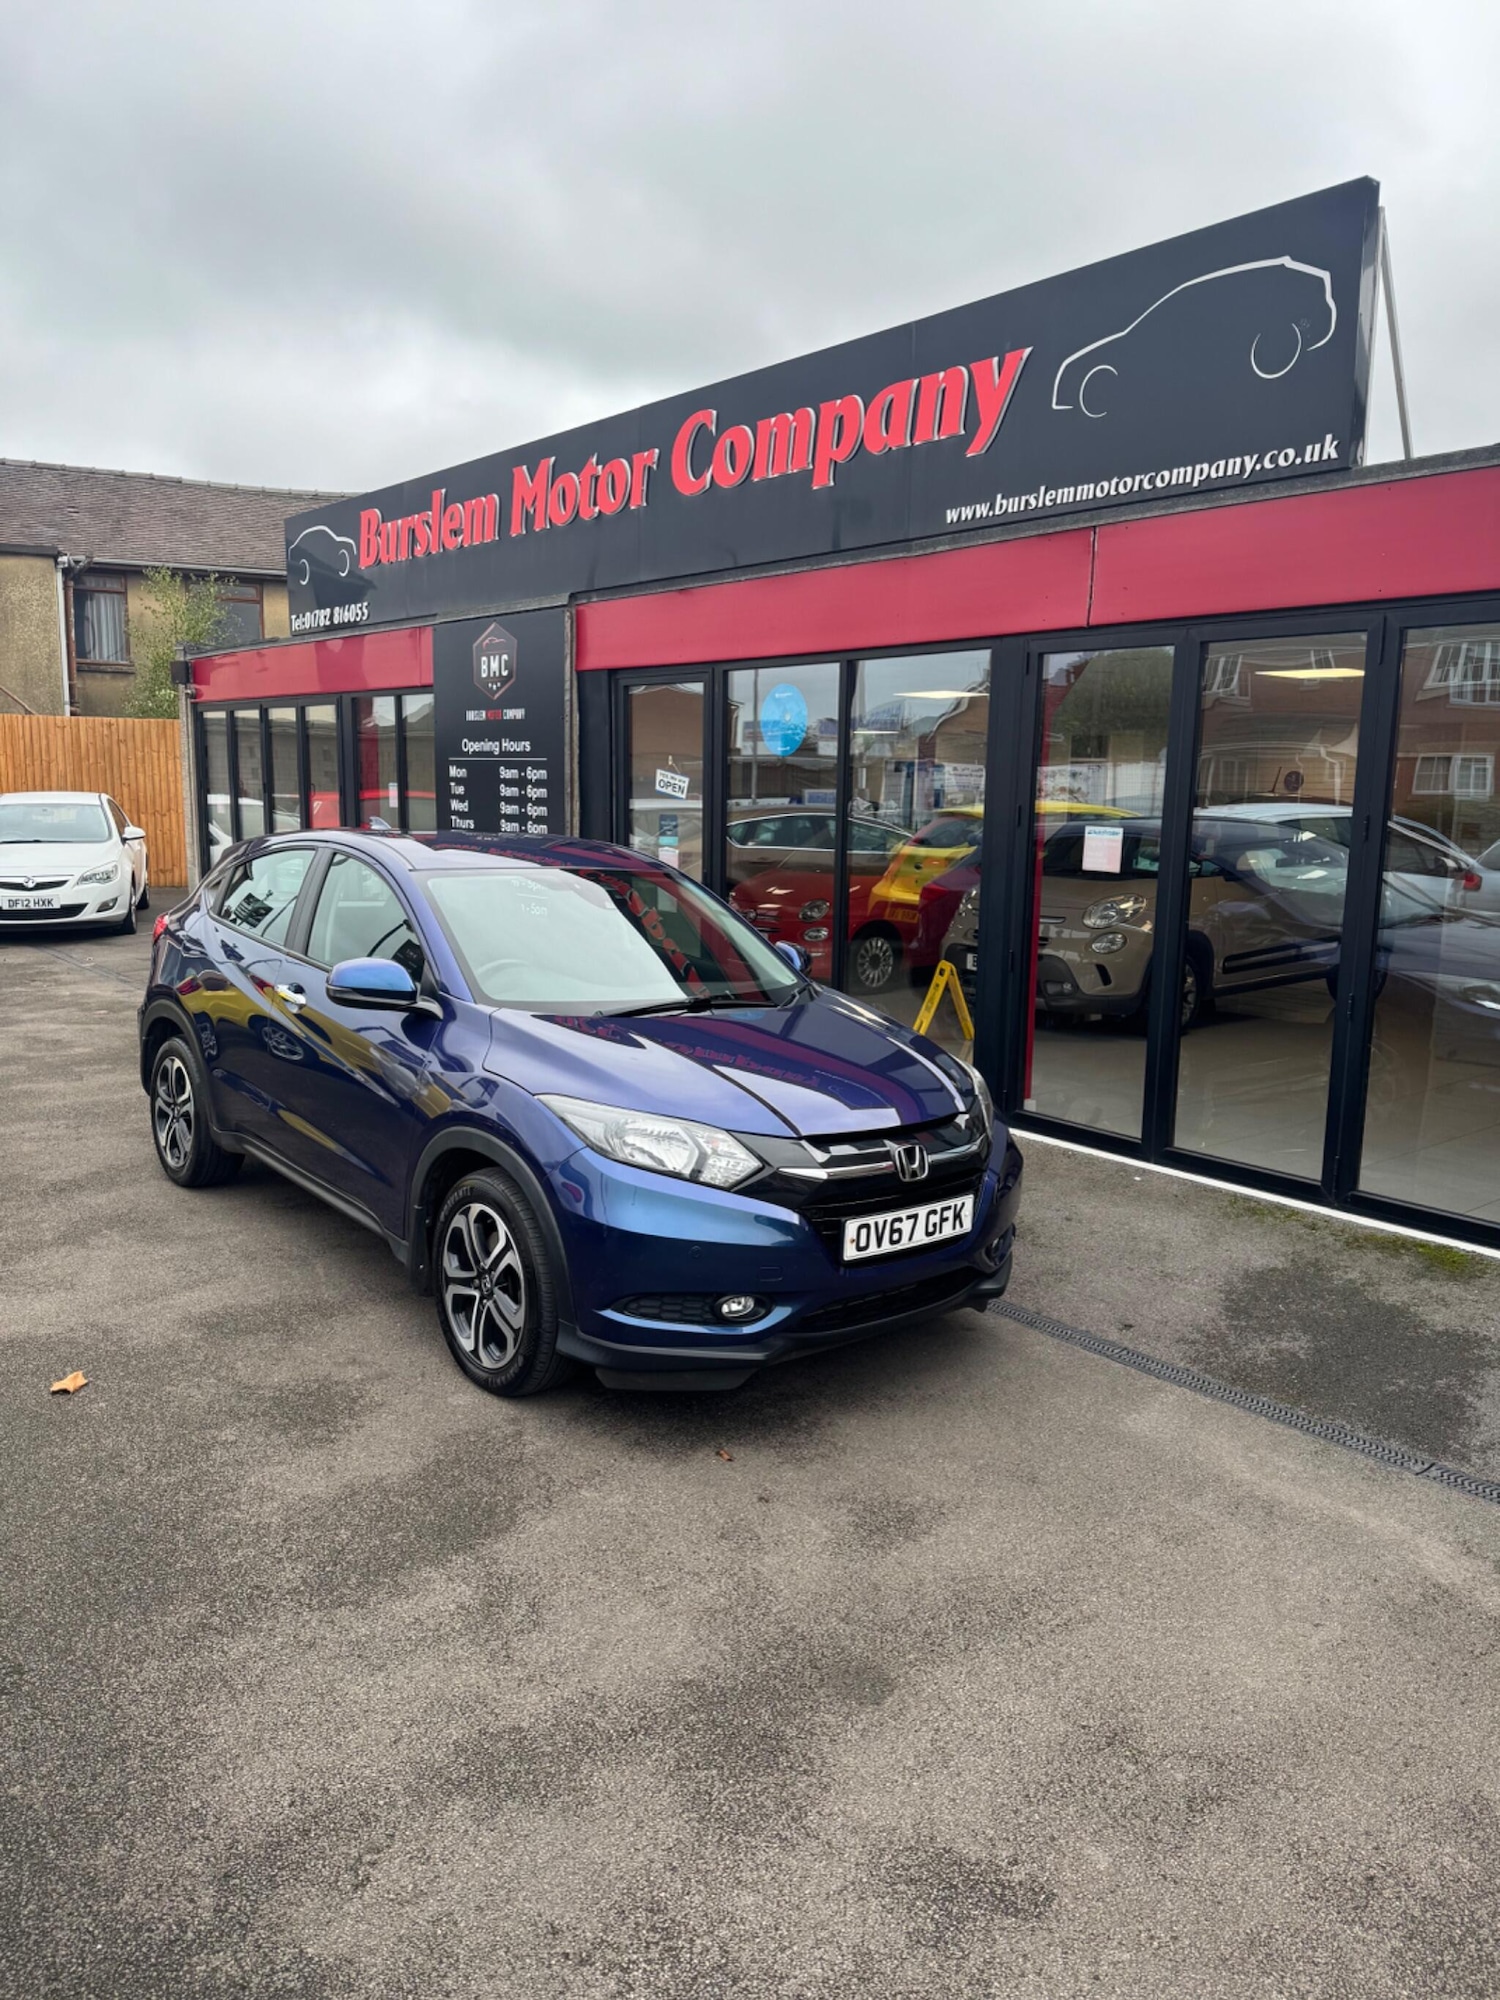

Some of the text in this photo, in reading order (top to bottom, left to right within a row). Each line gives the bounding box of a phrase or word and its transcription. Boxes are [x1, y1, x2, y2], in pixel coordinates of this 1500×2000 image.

[359, 346, 1034, 570] Burslem Motor Company
[945, 433, 1339, 525] www.burslemmotorcompany.co.uk
[333, 601, 369, 625] 816055
[480, 653, 509, 678] BMC
[461, 738, 531, 755] Opening Hours
[448, 765, 467, 778] Mon
[499, 766, 519, 779] 9am
[526, 766, 548, 782] 6pm
[449, 782, 465, 795] Tue
[499, 783, 519, 797] 9am
[526, 785, 548, 800] 6pm
[658, 778, 686, 796] OPEN
[450, 799, 469, 812] Wed
[499, 801, 519, 814] 9am
[526, 802, 548, 819] 6pm
[450, 815, 475, 829] Thurs
[499, 819, 520, 832] 9am
[8, 898, 54, 909] DF12 HXK
[855, 1201, 965, 1252] OV67 GFK
